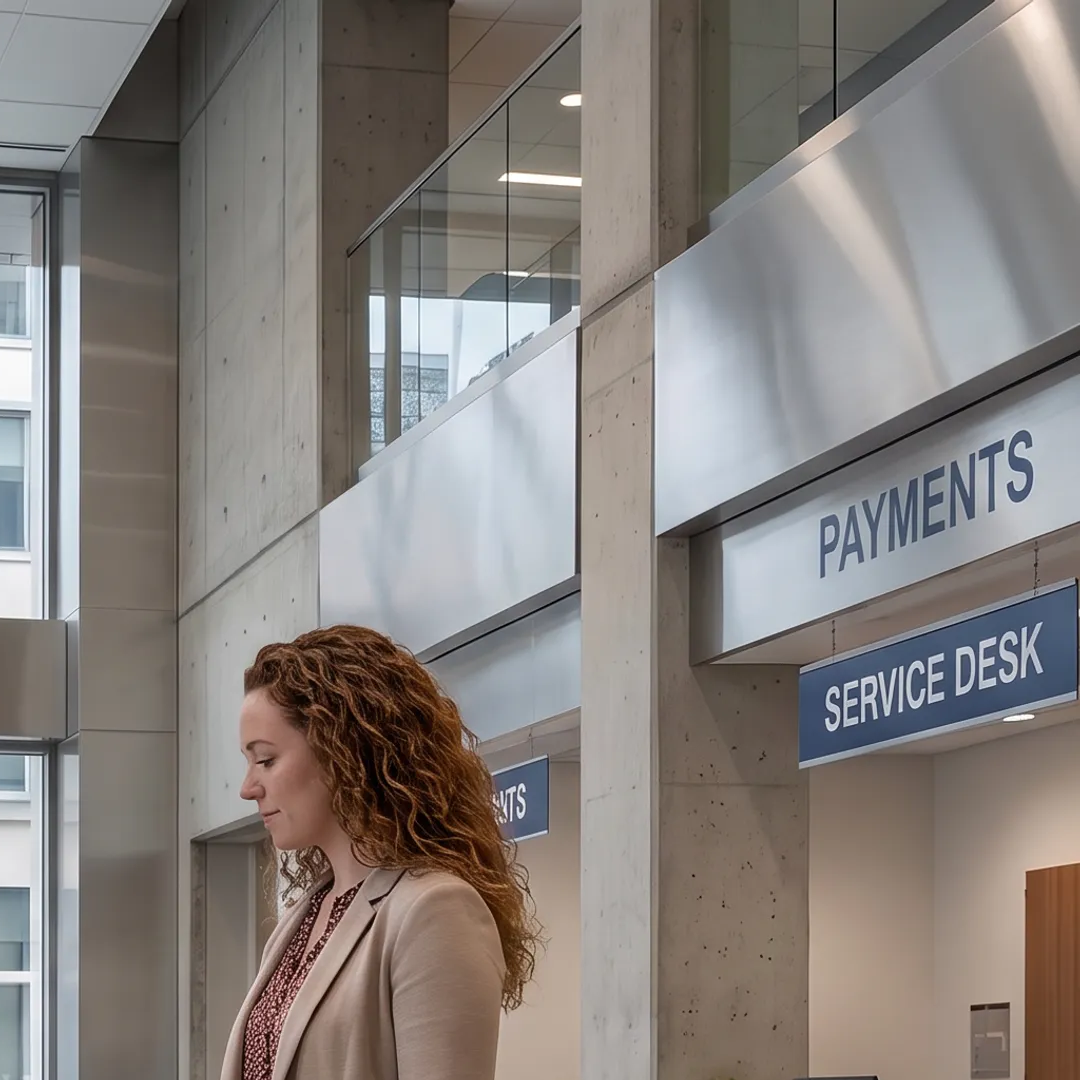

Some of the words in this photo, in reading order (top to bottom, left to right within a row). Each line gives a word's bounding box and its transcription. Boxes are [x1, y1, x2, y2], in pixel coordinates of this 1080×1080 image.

[820, 430, 1033, 578] PAYMENTS
[824, 652, 945, 732] SERVICE
[955, 622, 1044, 697] DESK
